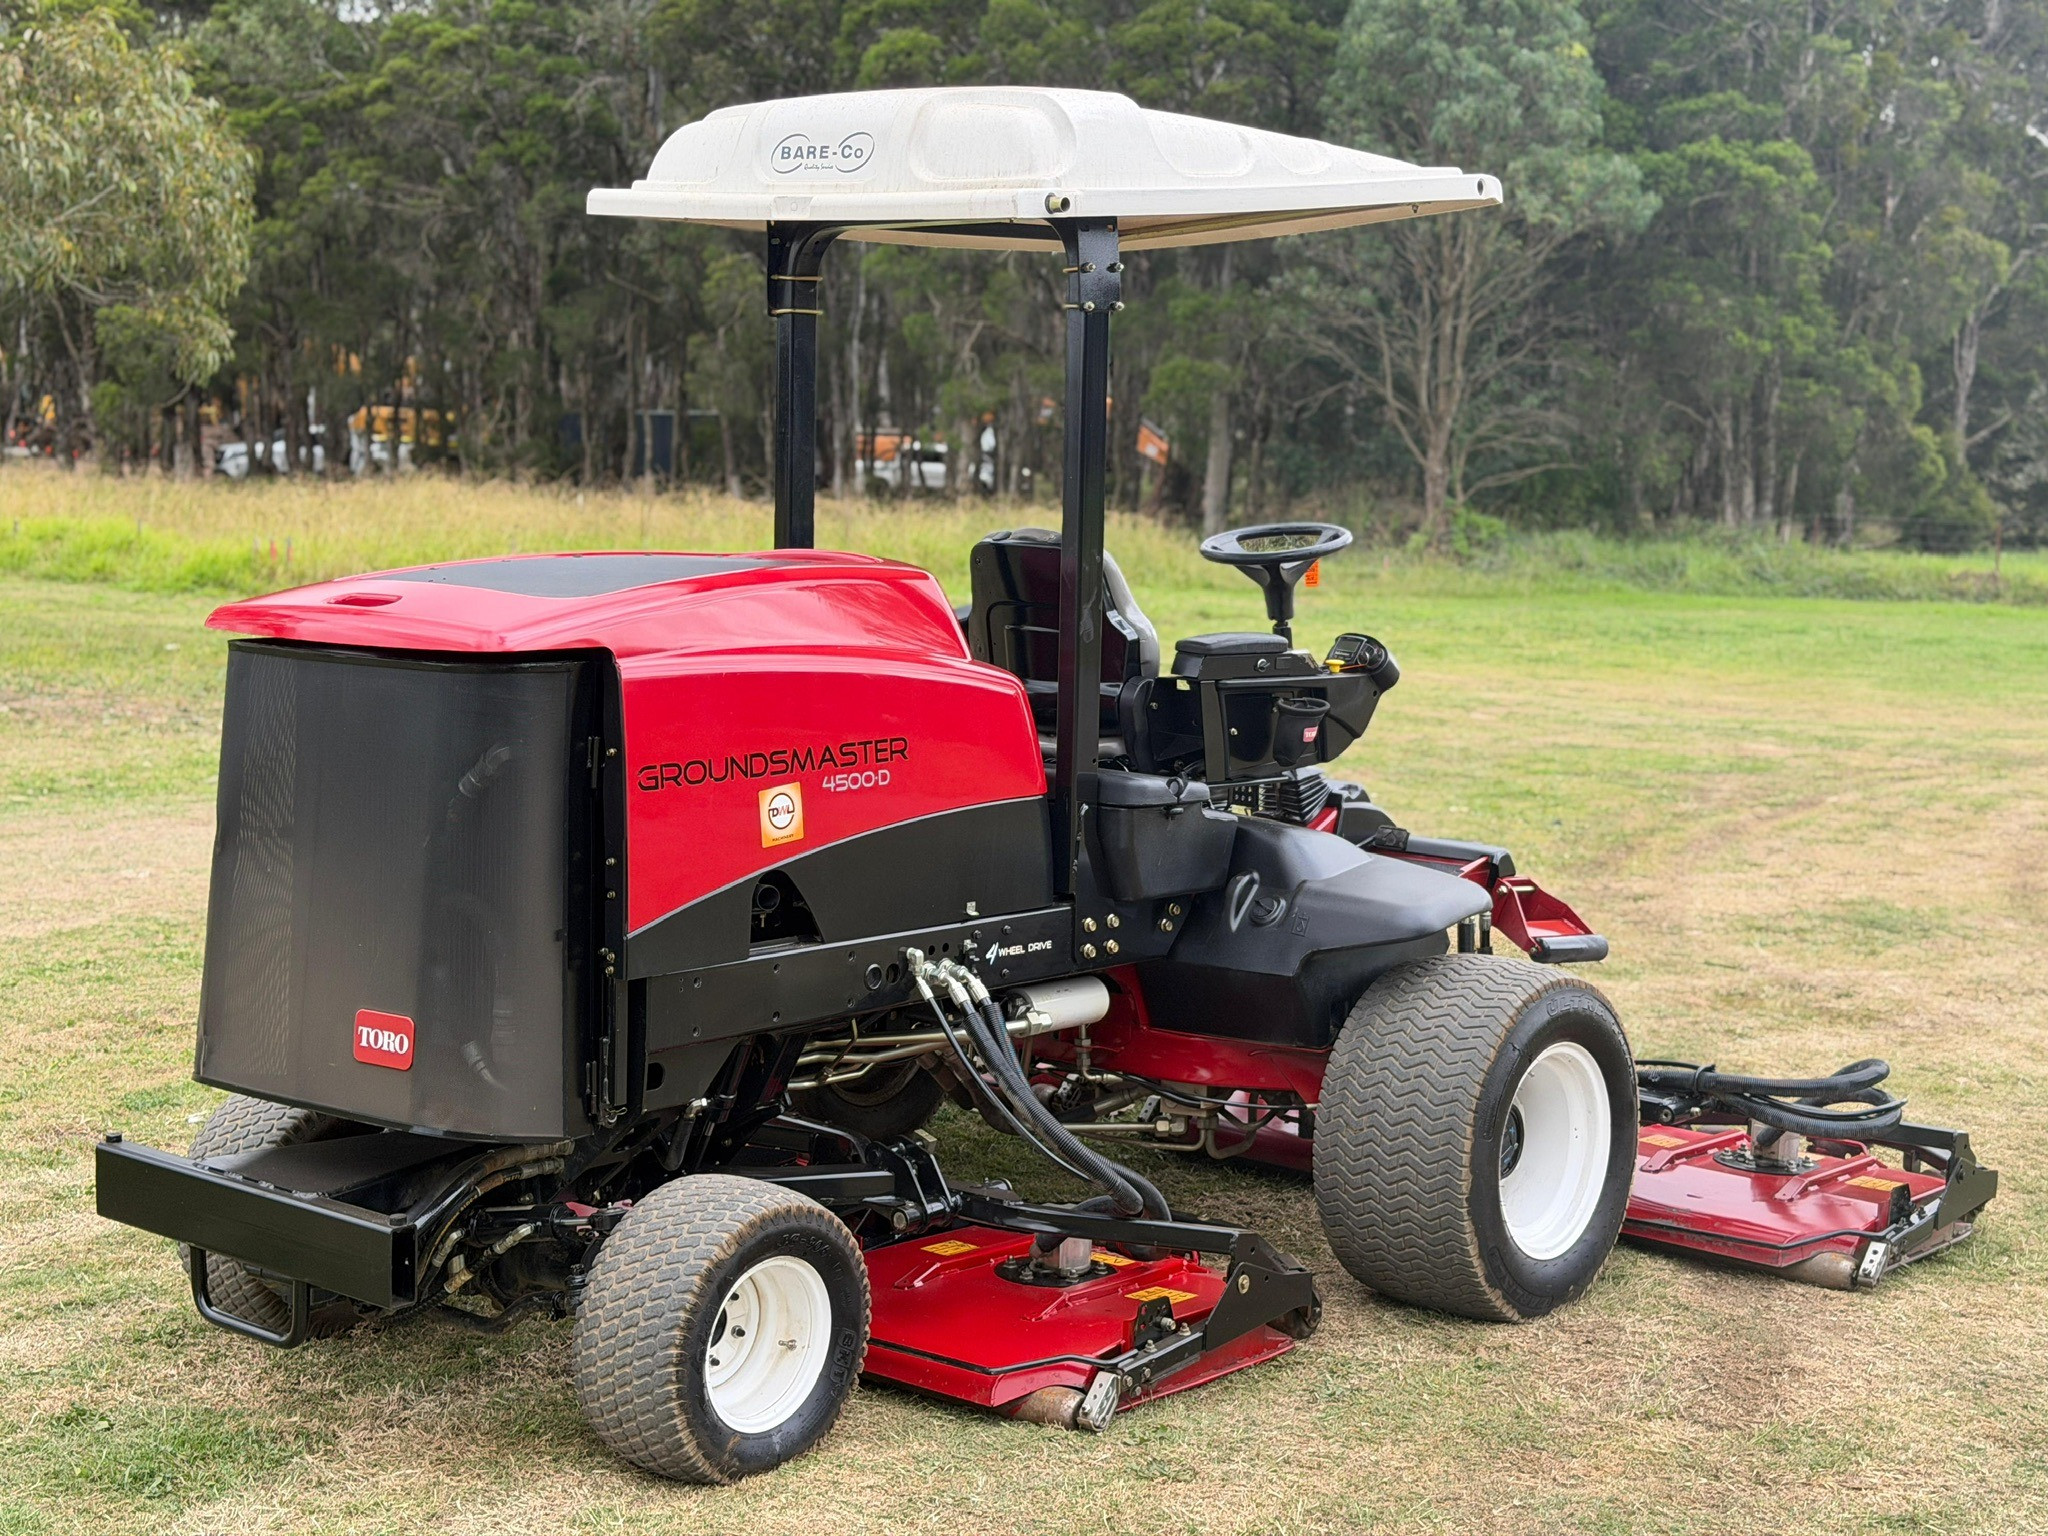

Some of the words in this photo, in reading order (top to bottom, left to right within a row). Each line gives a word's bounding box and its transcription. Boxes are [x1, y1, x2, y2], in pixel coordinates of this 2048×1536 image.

[781, 145, 864, 159] BARE-Co
[637, 737, 909, 791] GROUNDSMASTER
[985, 942, 999, 965] 4
[998, 945, 1025, 957] WHEEL
[1028, 940, 1052, 952] DRIVE
[358, 1026, 409, 1054] TORO
